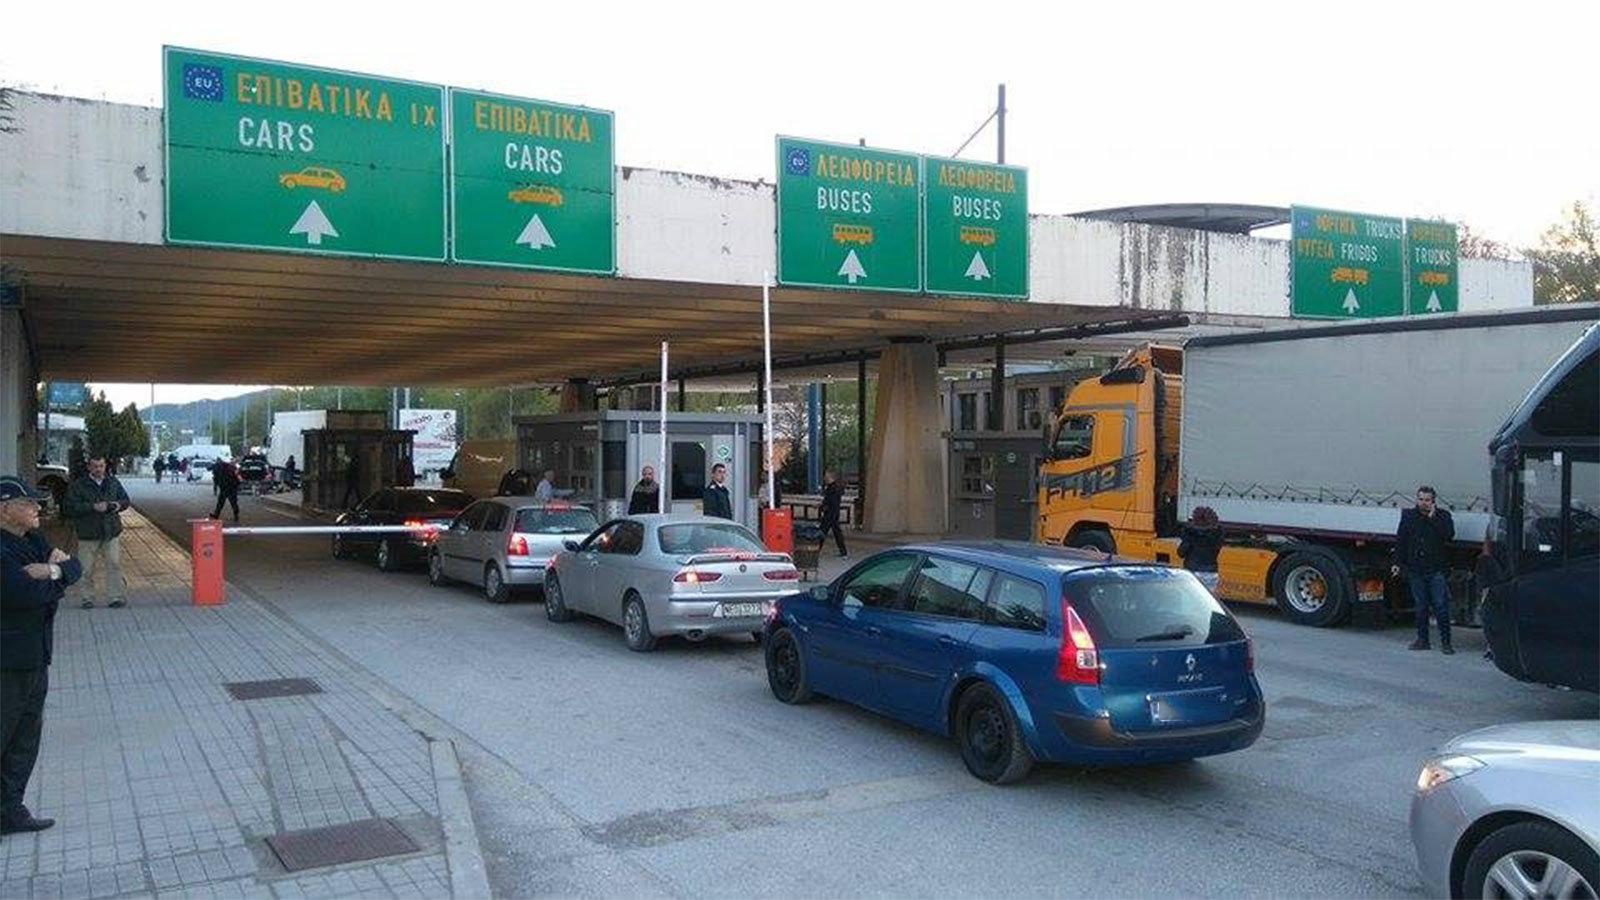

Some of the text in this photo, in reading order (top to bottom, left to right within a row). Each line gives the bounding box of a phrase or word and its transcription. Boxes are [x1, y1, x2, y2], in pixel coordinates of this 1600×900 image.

[237, 72, 392, 121] ΕΠΙΒΑΤΙΚΑ
[238, 117, 315, 151] CARS
[474, 100, 592, 143] ΕΠΙΒΑΤΙΚΑ
[505, 142, 563, 175] CARS
[816, 154, 915, 187] ΛΕΩΦΟΡΕΙΑ
[939, 164, 1016, 194] ΛΕΩΦΟΡΕΙΑ
[817, 186, 873, 214] BUSES
[953, 194, 1002, 221] BUSES
[1364, 218, 1402, 240] TRUCKS
[1414, 247, 1451, 266] TRUCKS
